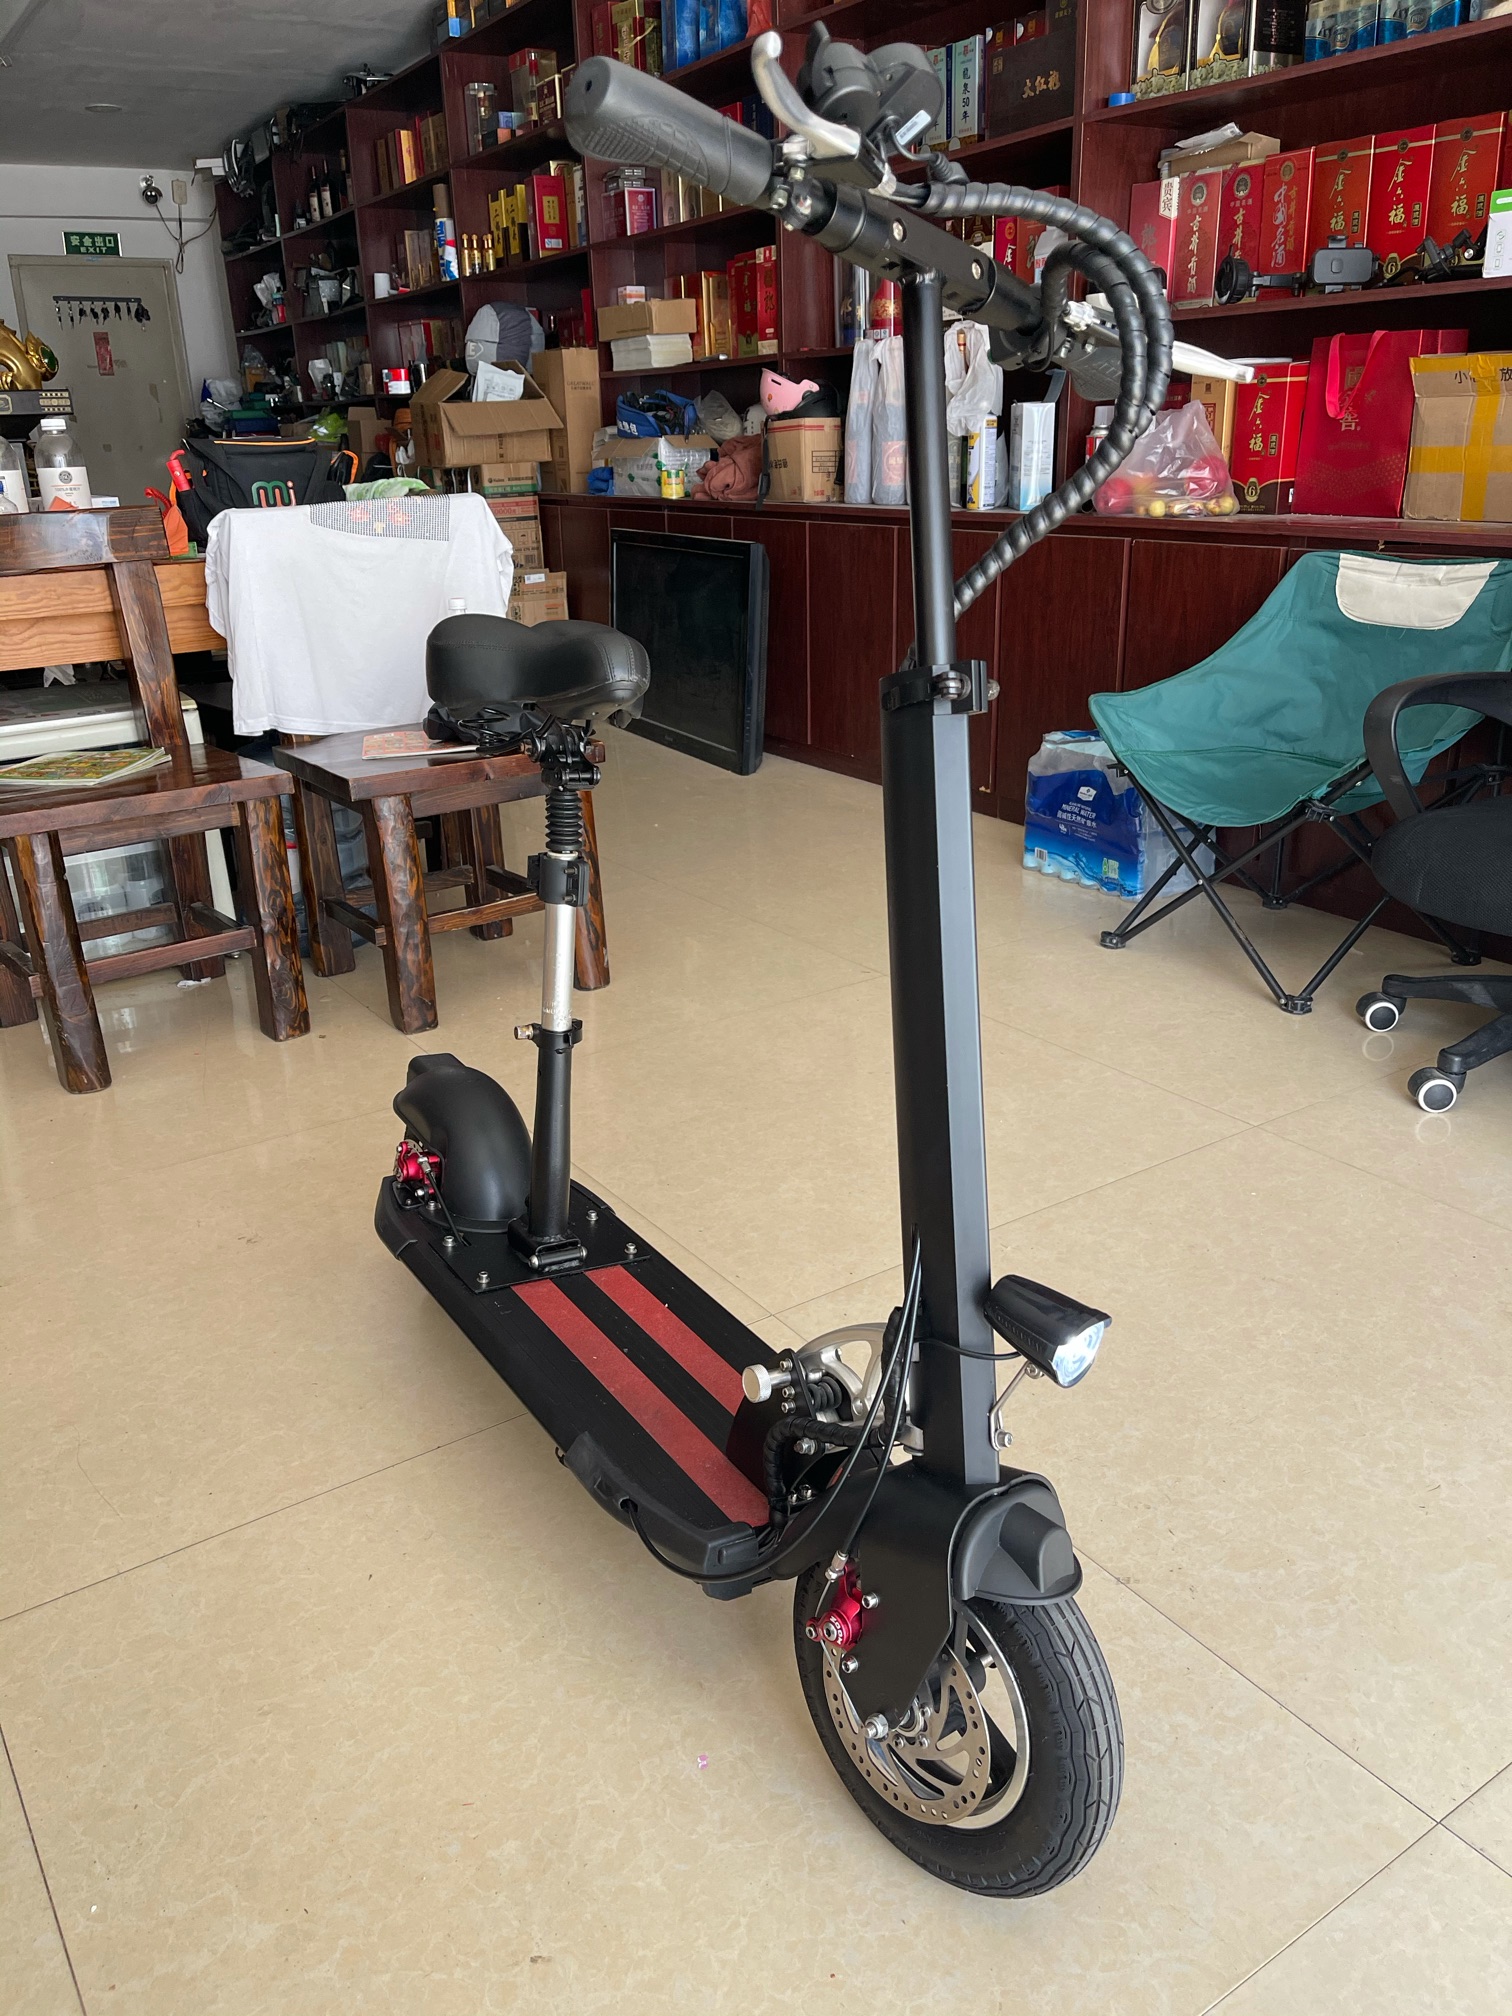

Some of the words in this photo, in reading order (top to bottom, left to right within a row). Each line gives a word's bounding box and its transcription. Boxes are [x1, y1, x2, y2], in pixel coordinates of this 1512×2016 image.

[1161, 181, 1174, 213] 贵宾
[70, 235, 115, 247] 安全出口
